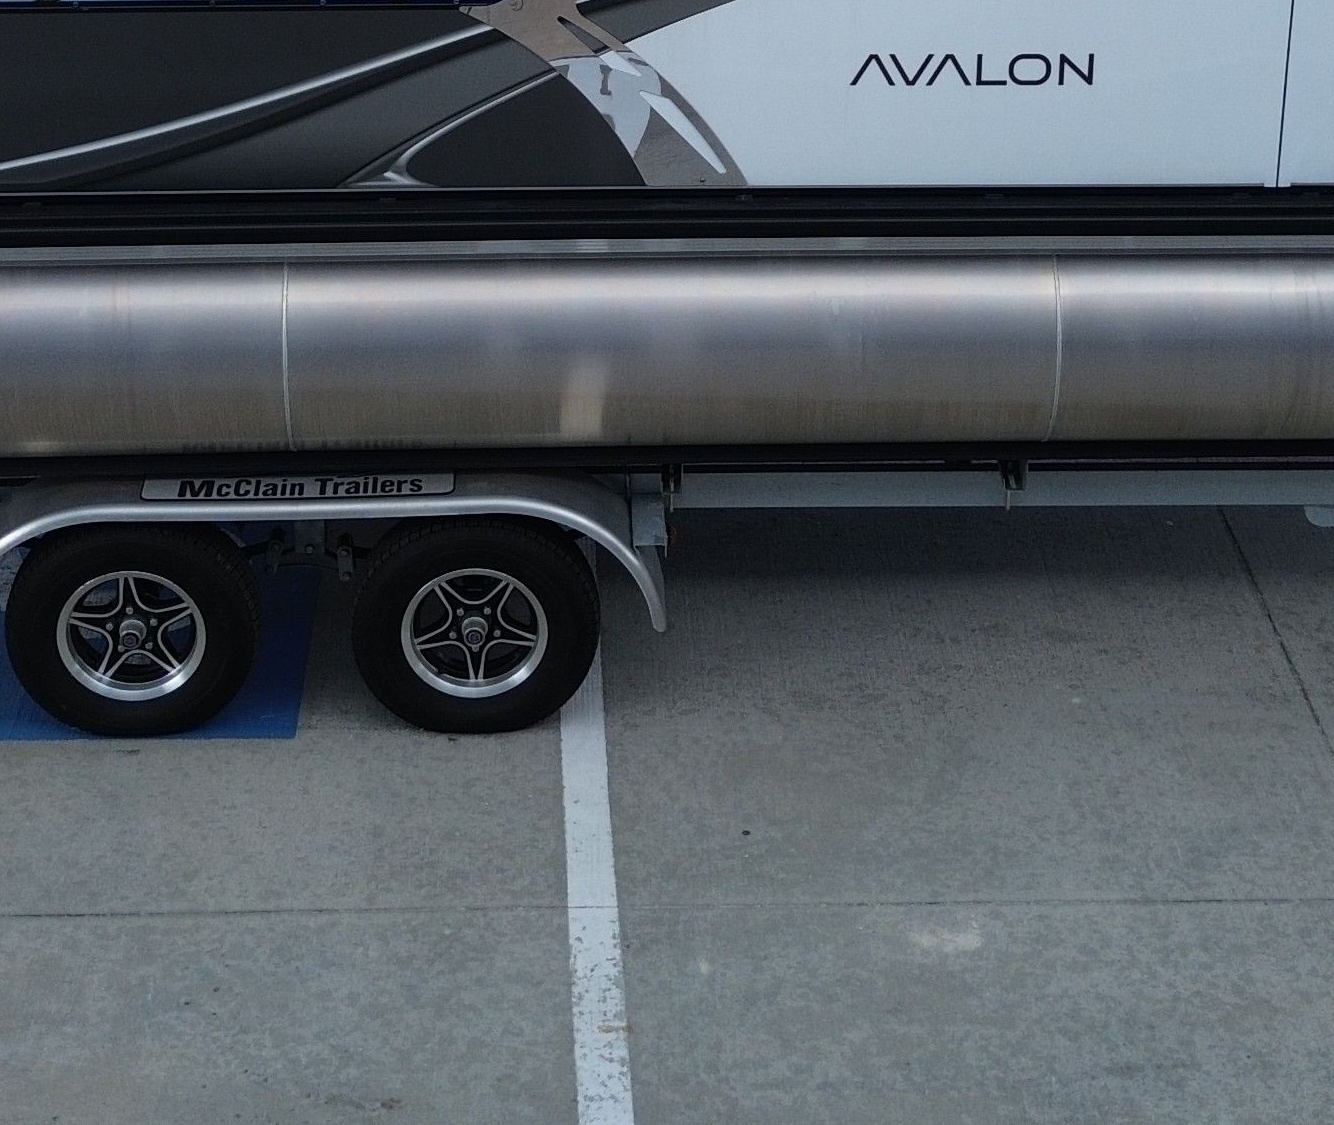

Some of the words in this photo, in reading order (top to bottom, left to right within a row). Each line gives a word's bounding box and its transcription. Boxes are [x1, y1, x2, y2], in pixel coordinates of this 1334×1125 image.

[849, 53, 1095, 86] AVALON
[177, 478, 305, 498] McClain
[314, 476, 424, 496] Trailers
